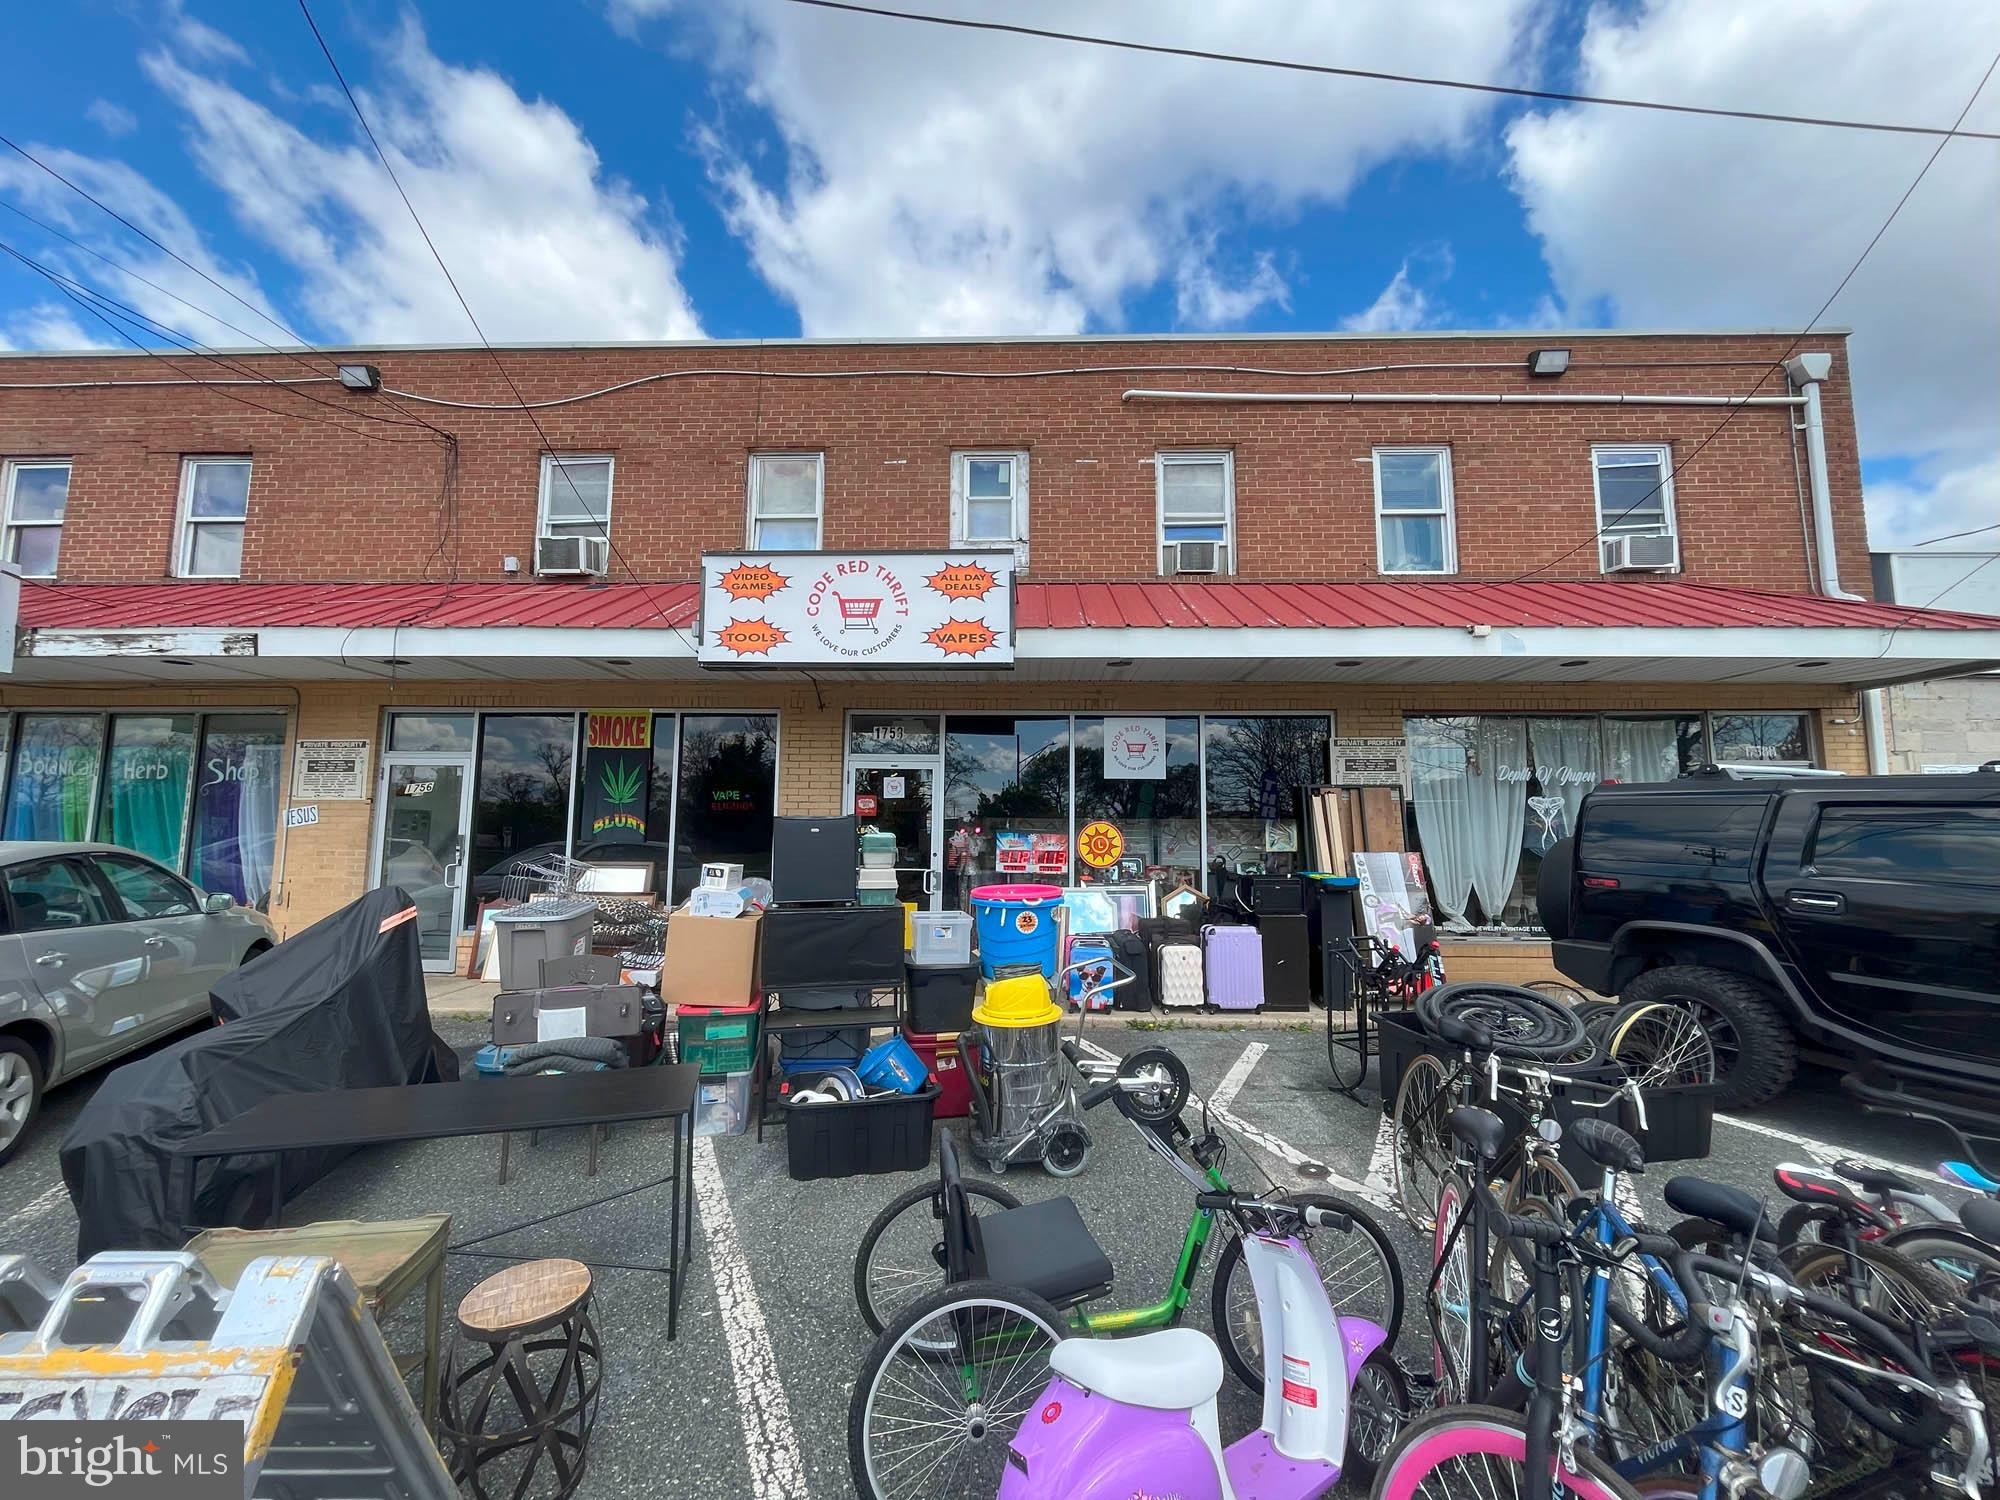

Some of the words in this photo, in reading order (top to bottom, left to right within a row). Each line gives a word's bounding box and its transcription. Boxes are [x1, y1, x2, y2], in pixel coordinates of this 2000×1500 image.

[731, 582, 774, 591] GAMES
[732, 572, 770, 581] VIDEO
[940, 573, 961, 581] ALL
[964, 573, 986, 581] DAY
[944, 582, 982, 591] DEALS
[806, 572, 835, 617] CODE
[836, 560, 870, 577] RED
[875, 564, 909, 617] THRIFT
[727, 633, 778, 643] TOOLS
[810, 623, 823, 641] WE
[818, 634, 840, 653] LOVE
[840, 648, 859, 657] OUR
[861, 623, 903, 657] CUSTOMERS
[936, 633, 987, 643] VAPES
[588, 715, 646, 746] SMOKE
[1143, 728, 1160, 752] THRIFT
[123, 759, 169, 781] Herb
[200, 758, 259, 796] Shop
[1496, 765, 1532, 784] Depth
[1536, 765, 1553, 785] Of
[712, 790, 740, 800] VAPE
[592, 812, 647, 835] BLUNT
[1410, 863, 1423, 889] Razor
